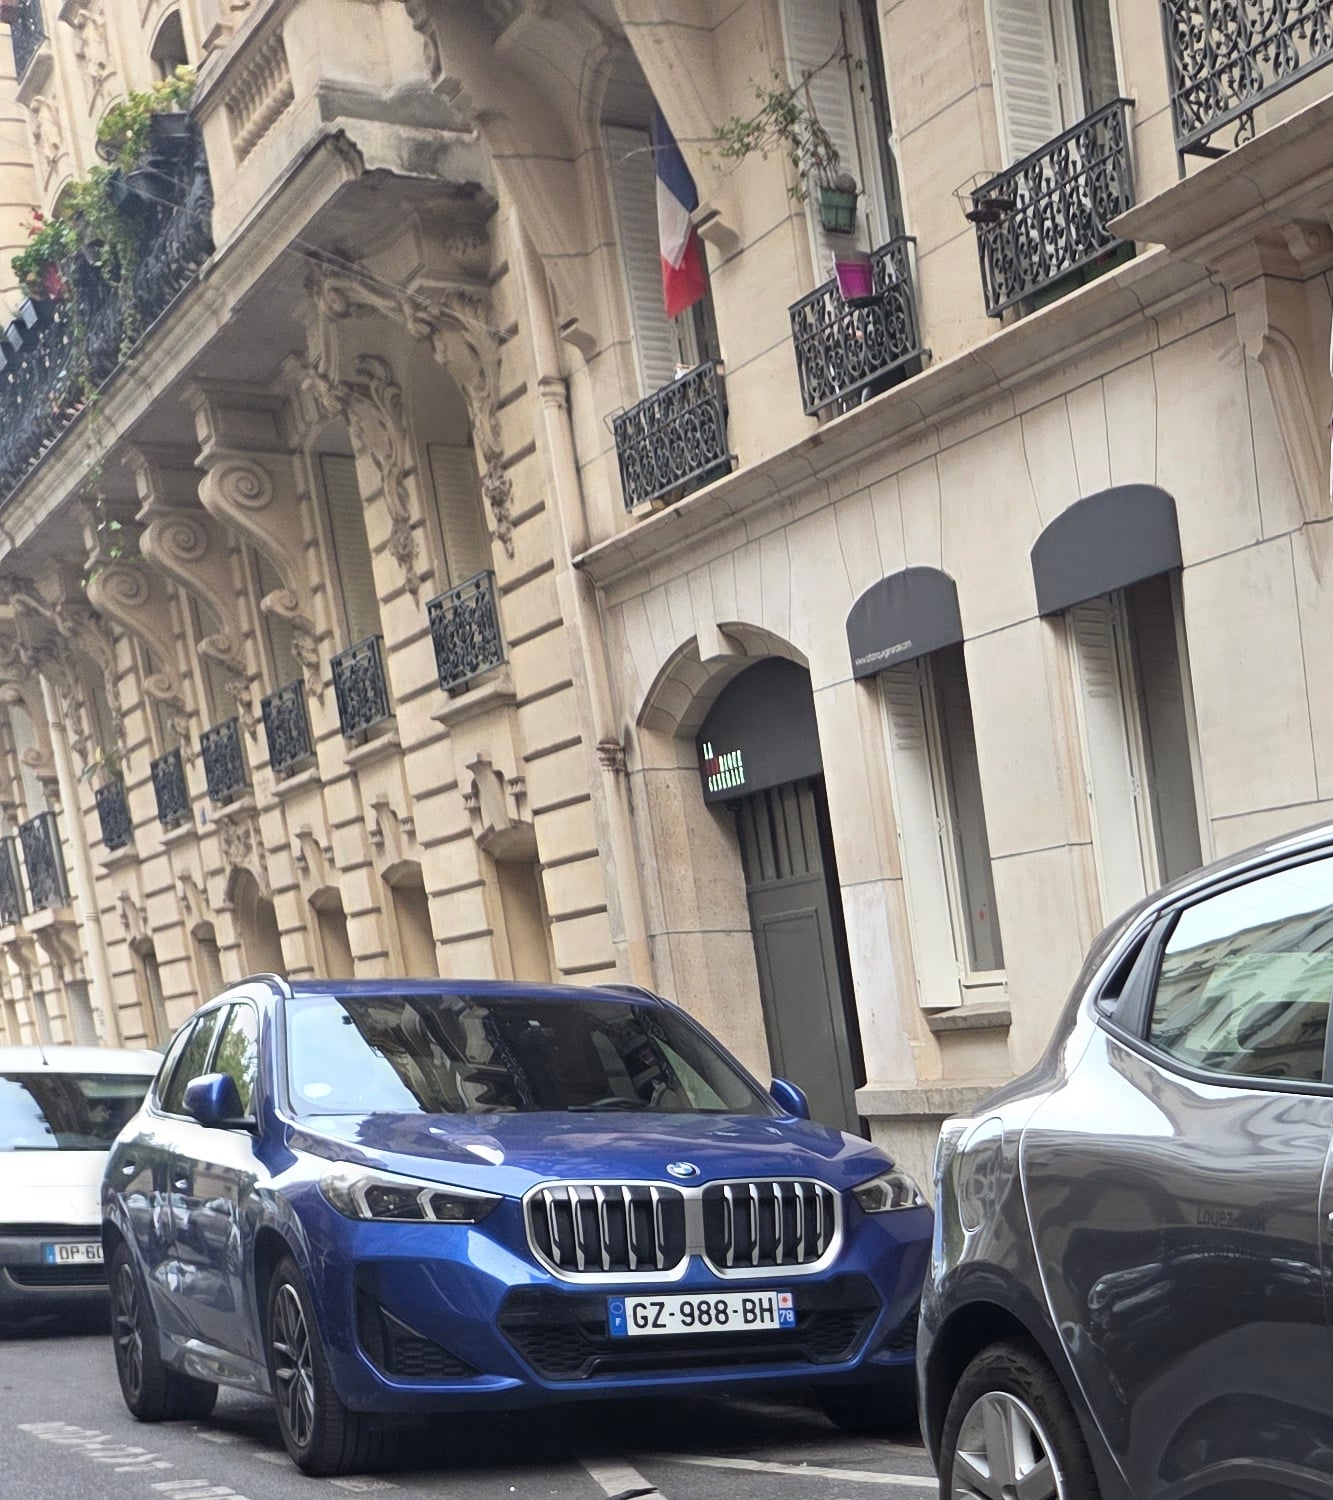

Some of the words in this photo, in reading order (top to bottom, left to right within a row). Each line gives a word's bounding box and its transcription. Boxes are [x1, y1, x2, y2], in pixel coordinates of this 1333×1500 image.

[615, 1317, 622, 1327] F
[632, 1296, 775, 1329] GZ-988-BH
[779, 1309, 794, 1323] 78
